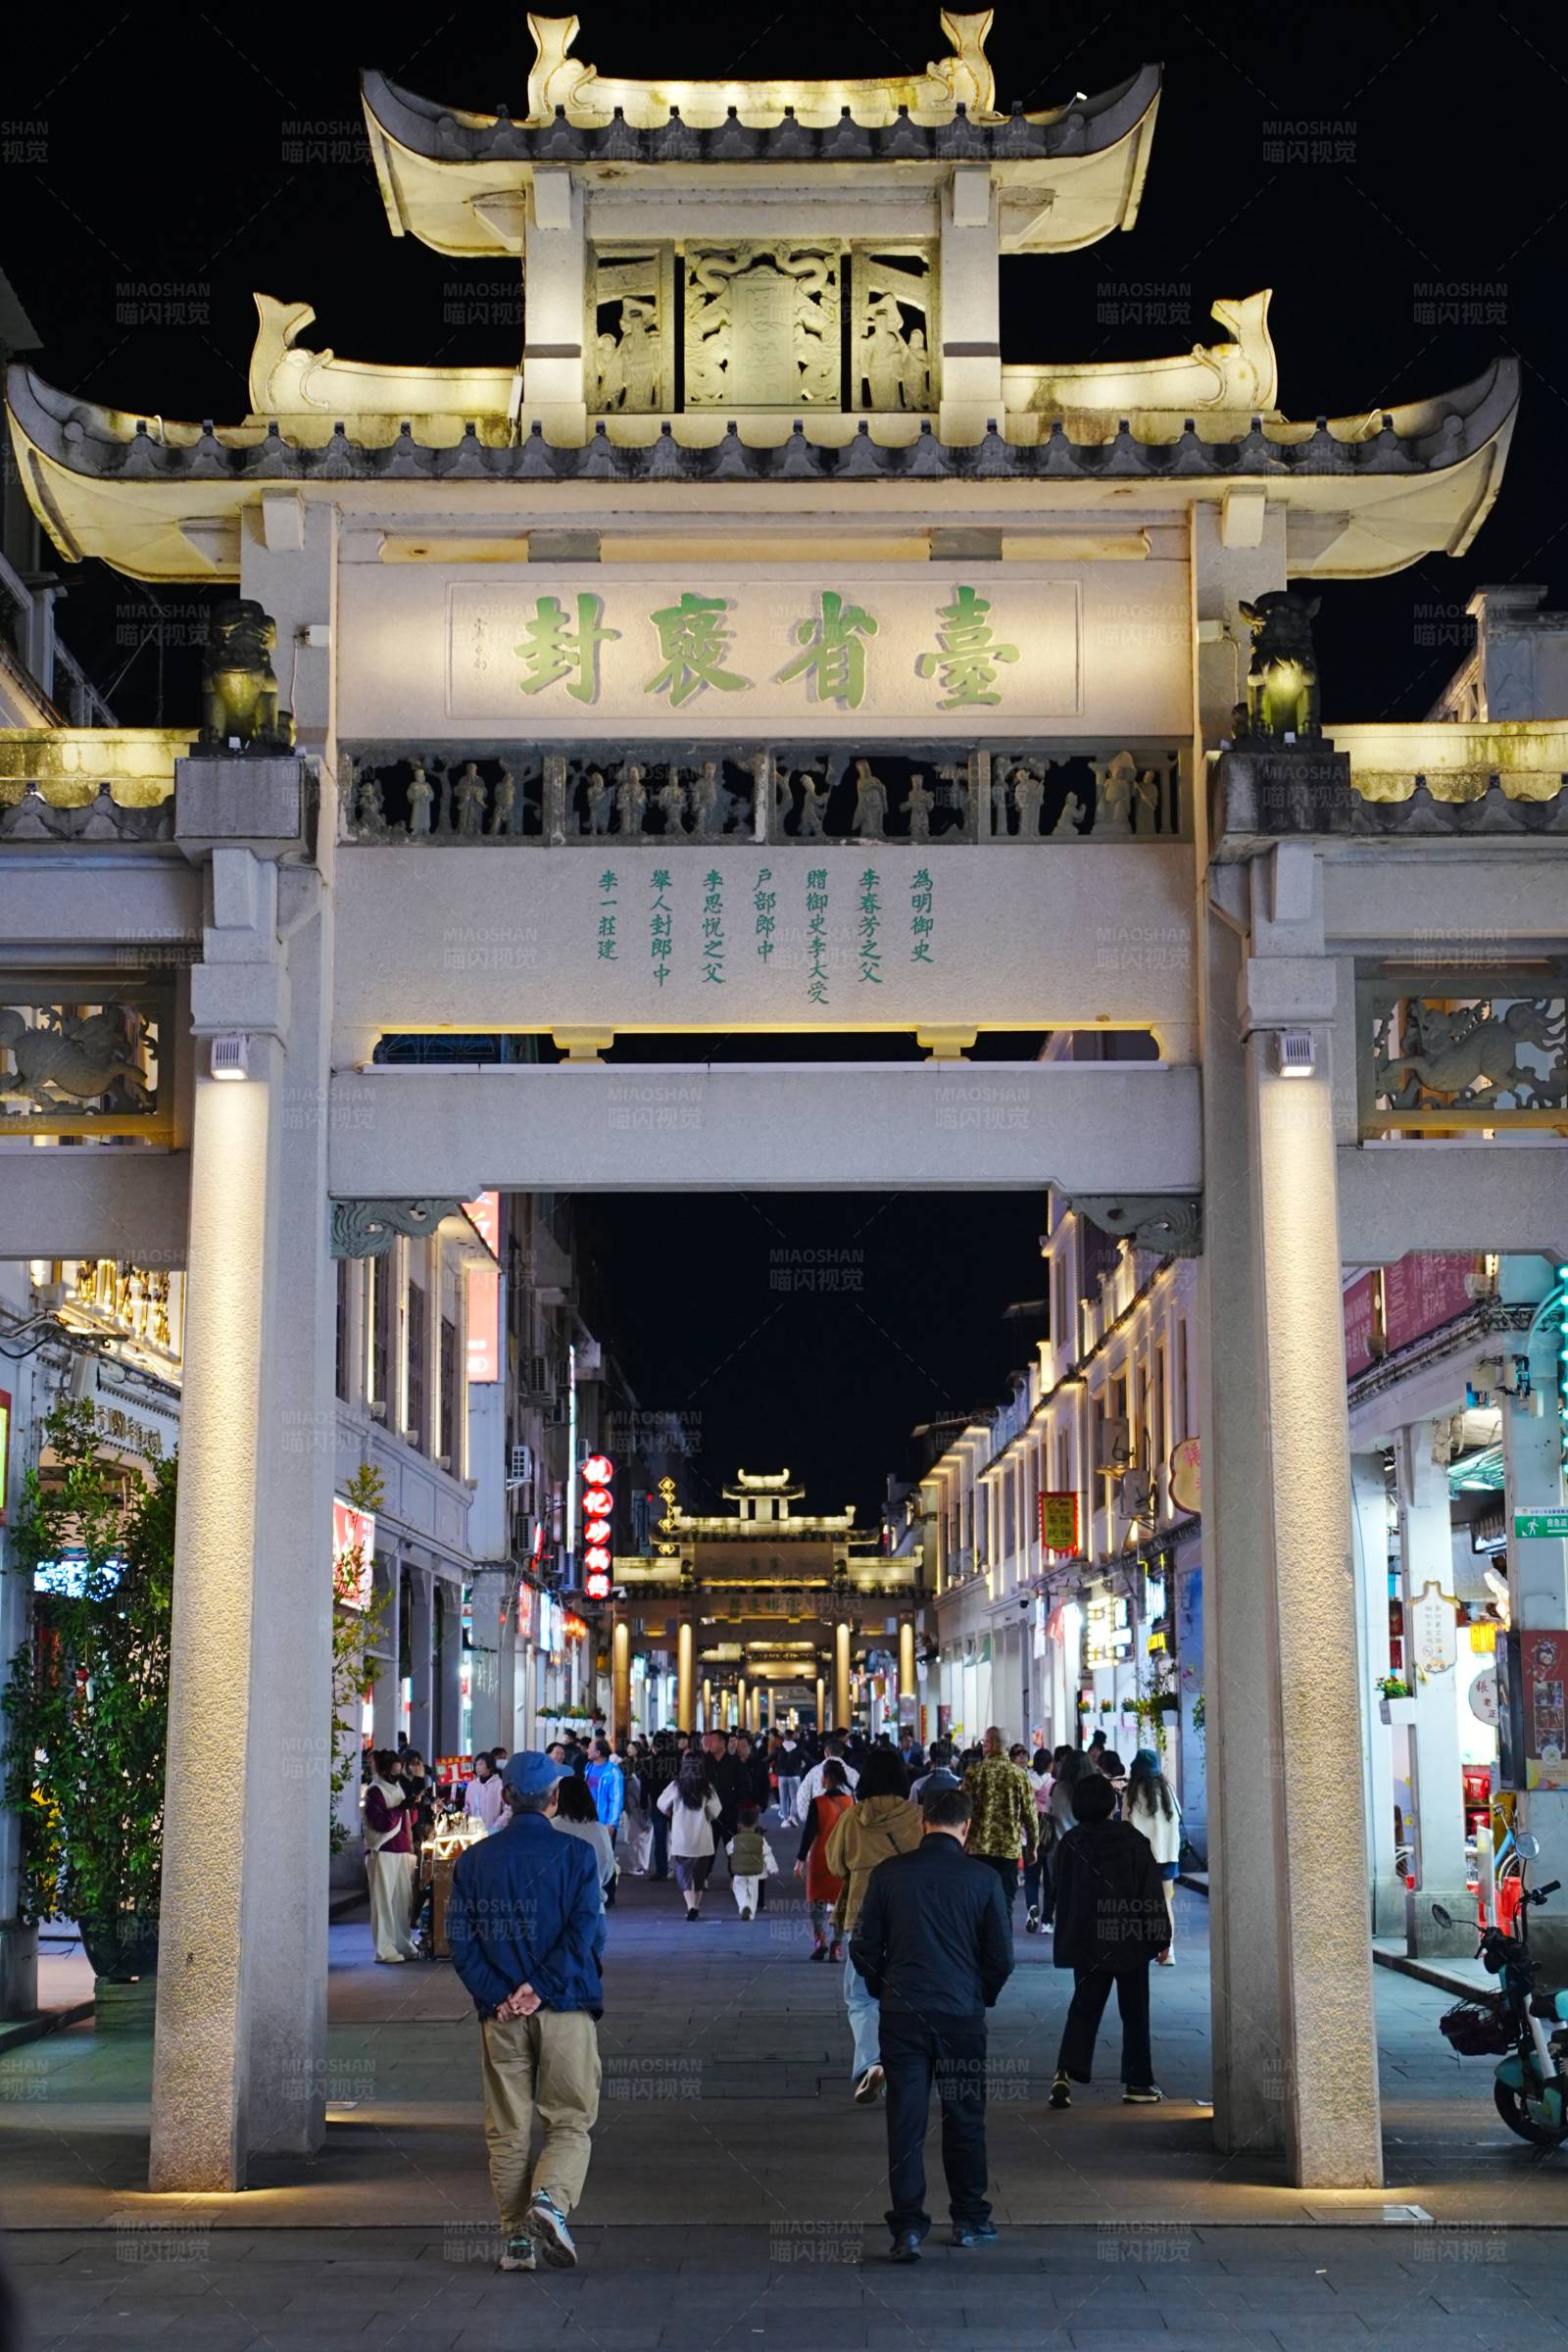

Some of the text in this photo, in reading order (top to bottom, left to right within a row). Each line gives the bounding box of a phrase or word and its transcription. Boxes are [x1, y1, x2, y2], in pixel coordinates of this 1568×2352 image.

[597, 869, 618, 960] 李一莊建
[807, 868, 829, 1004] 贈御史李大受
[858, 868, 882, 984] 李春芳之父
[909, 868, 935, 963] 為明御史
